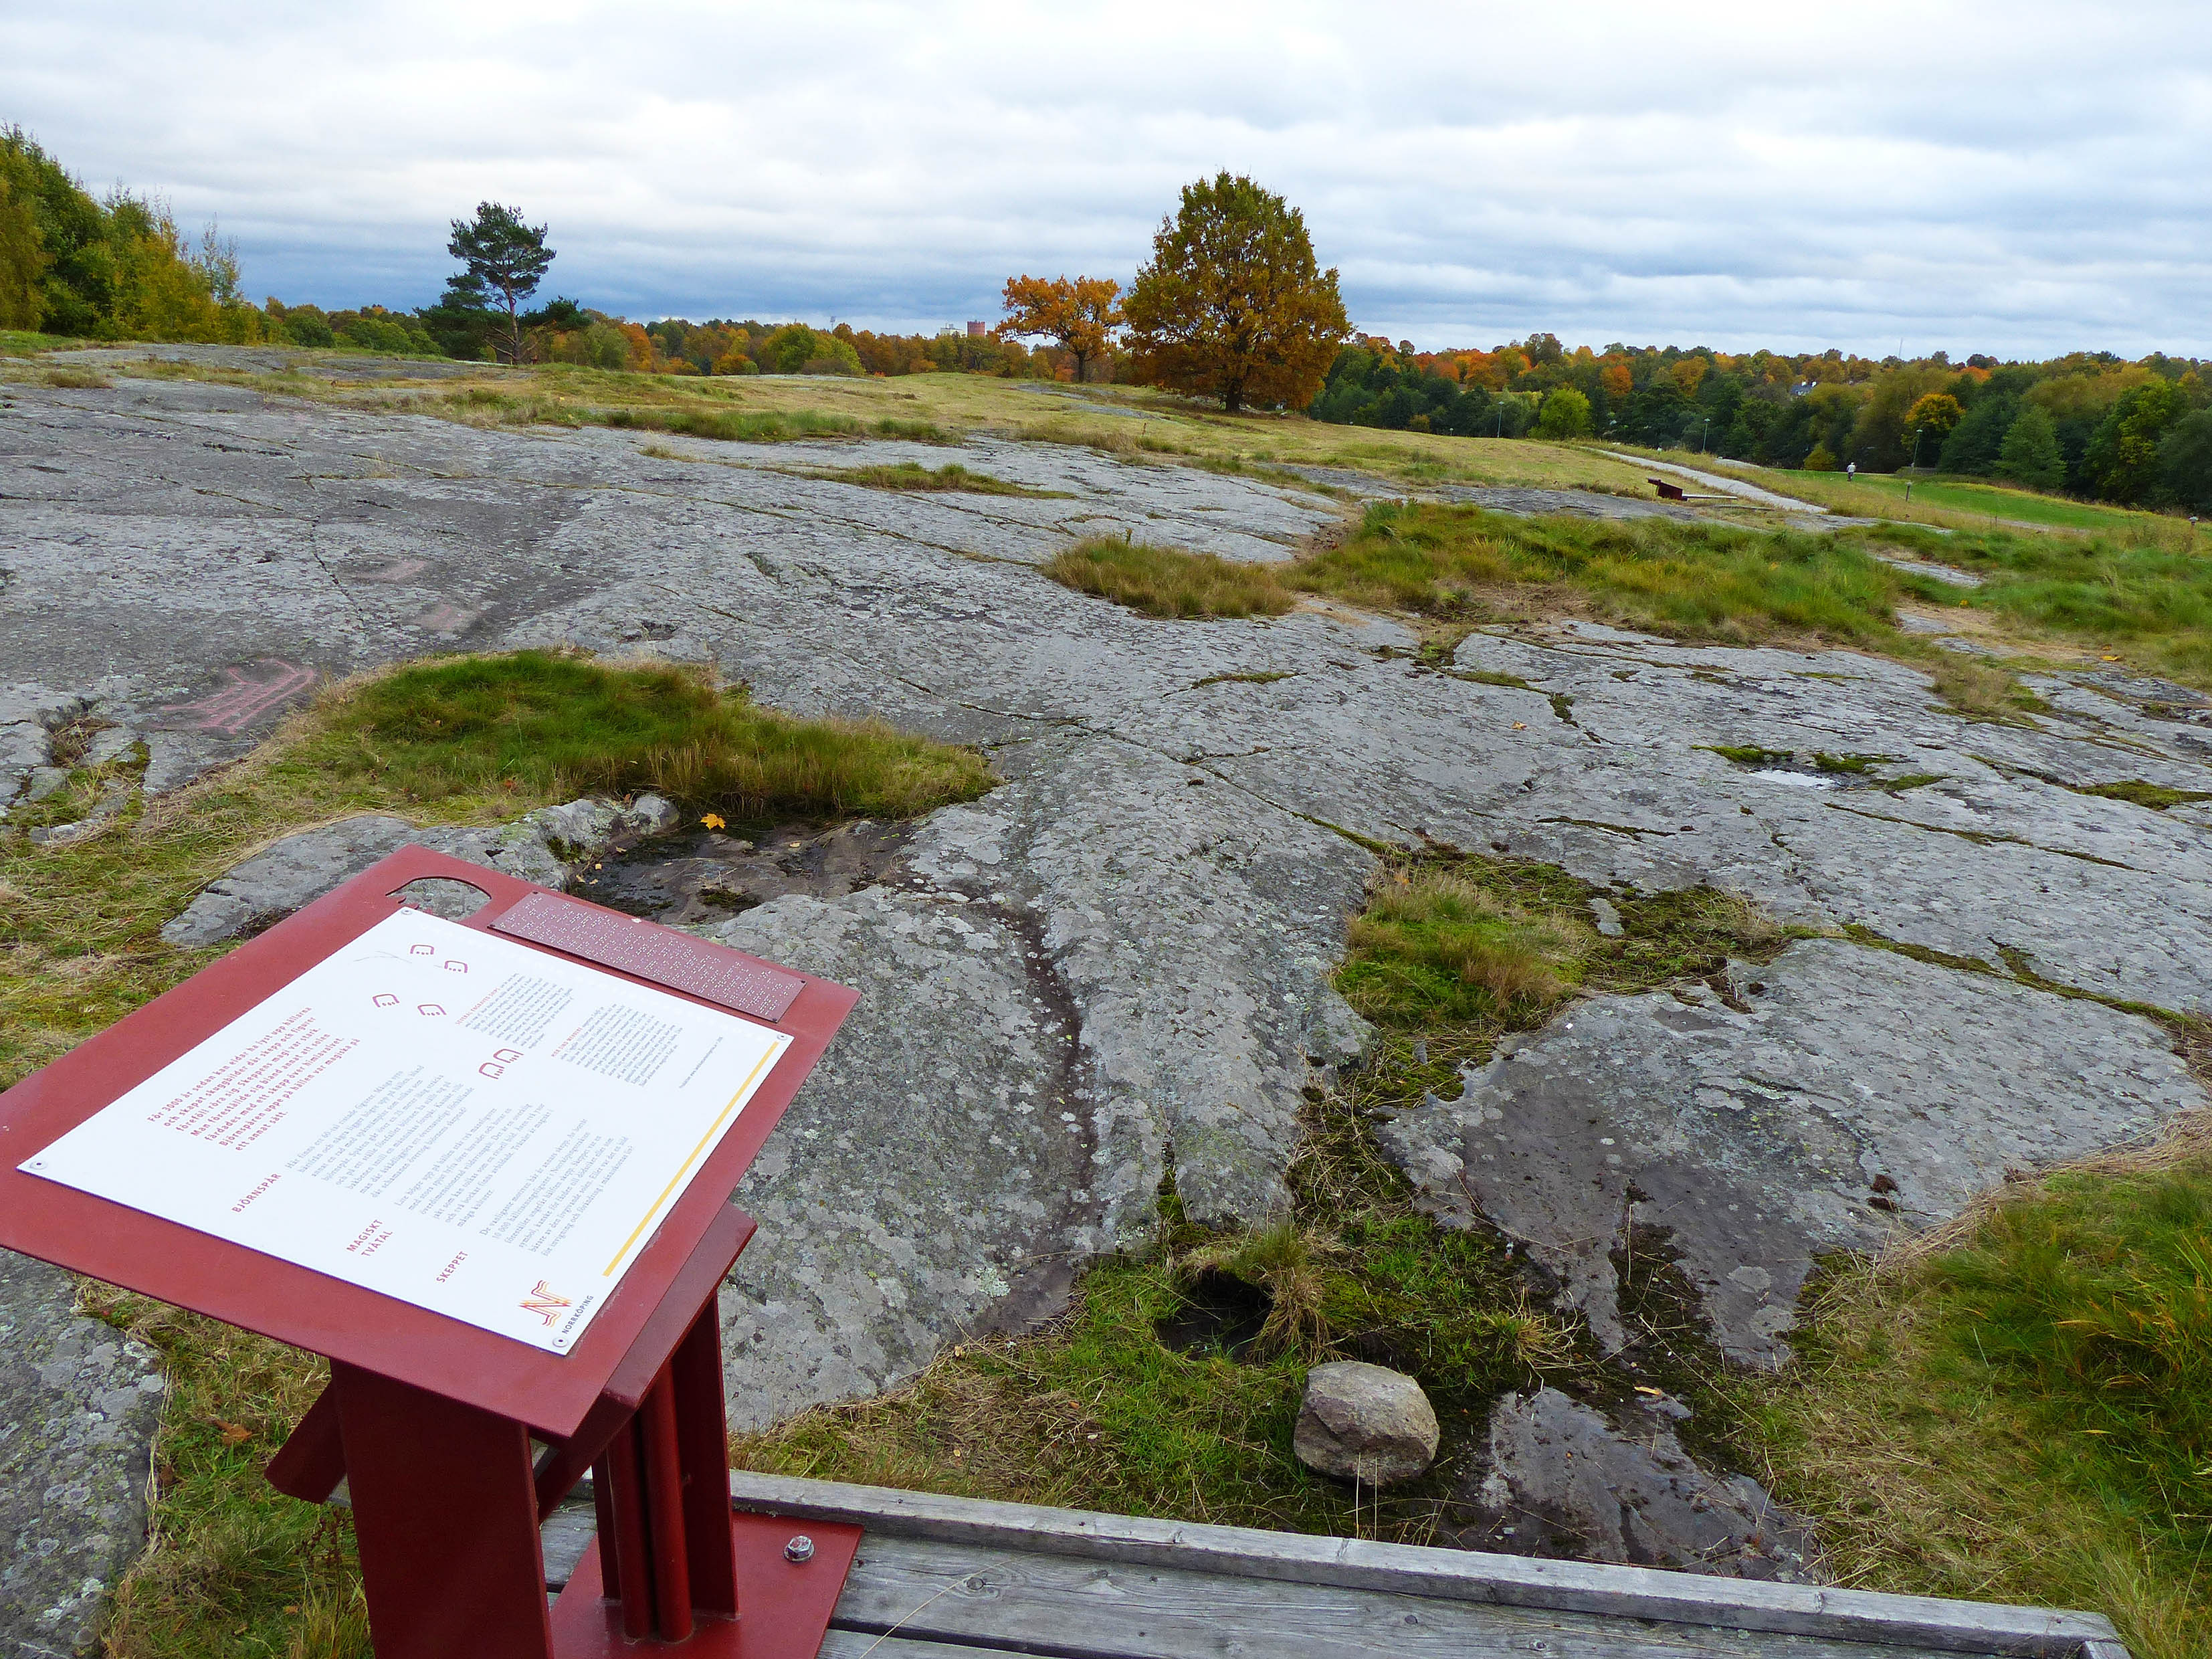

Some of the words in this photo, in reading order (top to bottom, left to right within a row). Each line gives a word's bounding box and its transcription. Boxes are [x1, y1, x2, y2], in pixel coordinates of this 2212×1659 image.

[146, 1111, 164, 1121] För
[161, 1098, 183, 1111] 3000
[191, 1075, 216, 1091] sedan
[211, 1065, 230, 1075] kan
[229, 1051, 248, 1065] eldar
[255, 1035, 273, 1044] lyst
[270, 1026, 286, 1035] upp
[282, 1007, 311, 1026] hällarna
[163, 1116, 180, 1127] och
[178, 1096, 206, 1116] skapat
[205, 1066, 247, 1096] skuggbilder
[246, 1056, 261, 1066] där
[260, 1042, 282, 1056] skepp
[280, 1033, 294, 1042] och
[290, 1017, 315, 1033] figurer
[175, 1108, 209, 1131] föreföll
[207, 1097, 226, 1109] röra
[224, 1087, 241, 1096] sig.
[237, 1062, 273, 1086] Skeppens
[270, 1048, 290, 1062] magi
[288, 1041, 301, 1049] var
[300, 1028, 320, 1041] stark.
[189, 1123, 210, 1136] Man
[207, 1093, 252, 1123] föreställde
[249, 1084, 264, 1093] sig
[259, 1068, 283, 1084] bland
[281, 1054, 303, 1069] annat
[300, 1046, 314, 1054] att
[311, 1034, 330, 1046] solen
[203, 1116, 241, 1141] färdades
[239, 1102, 258, 1116] med
[256, 1094, 270, 1102] ett
[267, 1078, 290, 1094] skepp
[286, 1066, 305, 1078] över
[301, 1038, 344, 1066] himlavalvet.
[218, 1112, 266, 1146] Björnspåren
[264, 1098, 284, 1112] uppe
[282, 1090, 294, 1098] på
[289, 1074, 314, 1090] hällen
[312, 1064, 326, 1074] var
[324, 1045, 352, 1065] magiska
[235, 1141, 249, 1151] ett
[247, 1123, 271, 1141] annat
[269, 1112, 288, 1124] sätt.
[231, 1173, 281, 1212] BJÖRNSPÅR
[346, 1219, 383, 1252] MAGISKT
[361, 1231, 393, 1256] TVÅTAL
[435, 1250, 468, 1282] SKEPPET
[561, 1295, 594, 1334] NORRKÖPING
